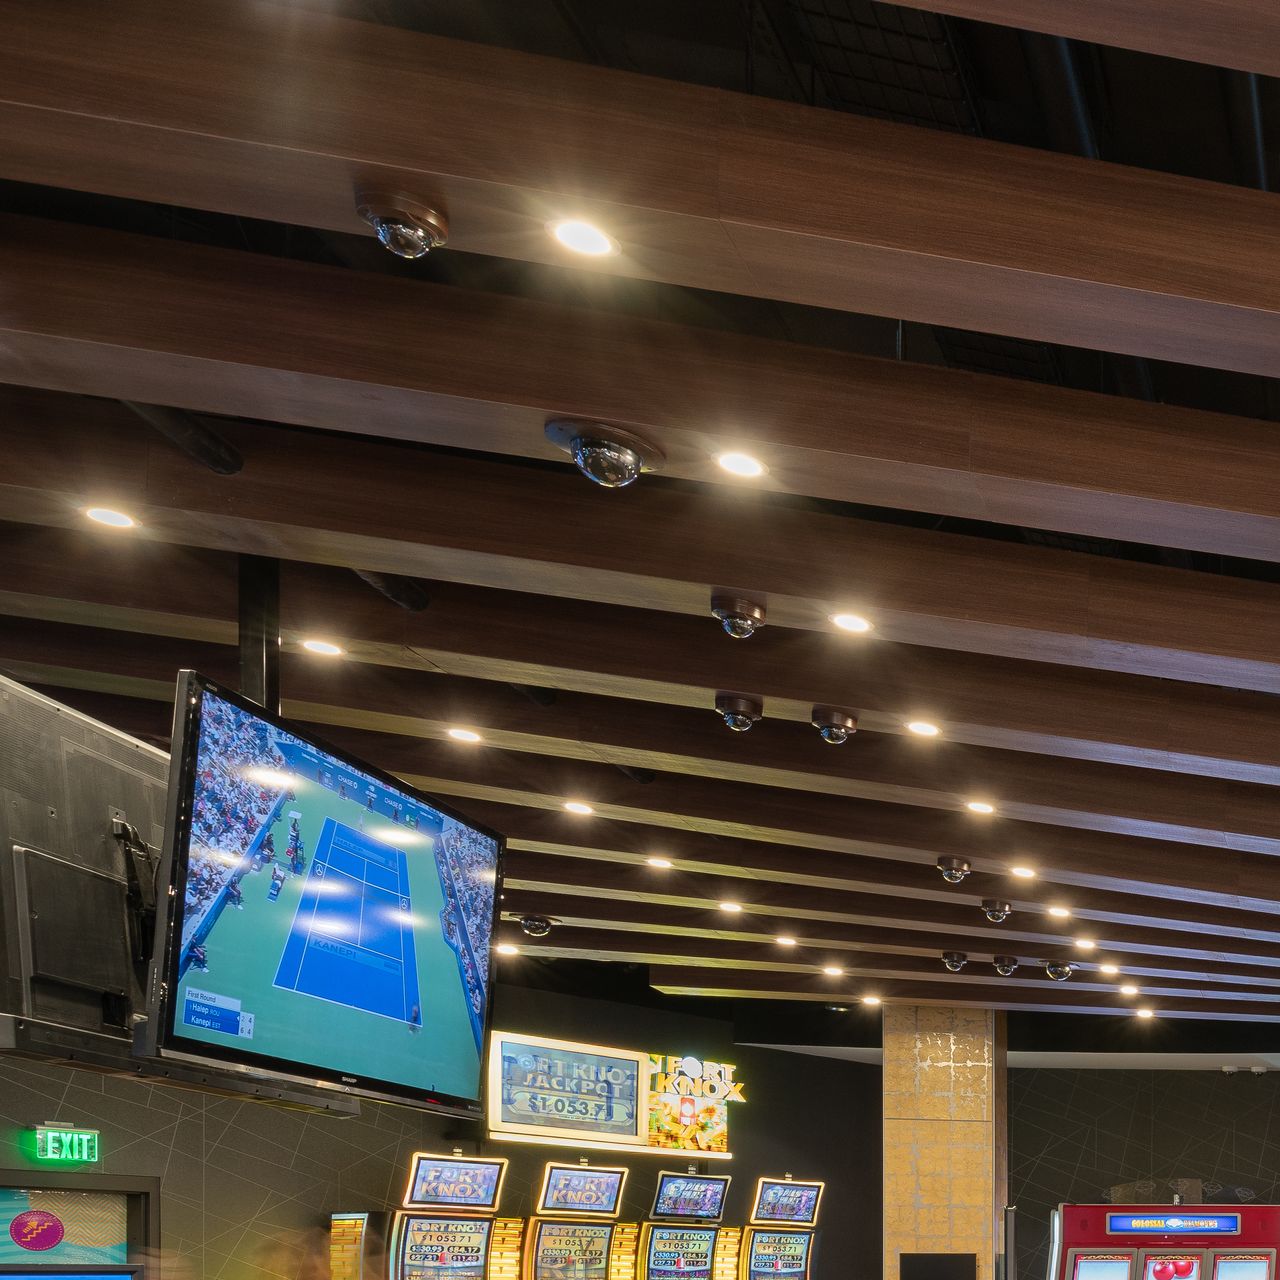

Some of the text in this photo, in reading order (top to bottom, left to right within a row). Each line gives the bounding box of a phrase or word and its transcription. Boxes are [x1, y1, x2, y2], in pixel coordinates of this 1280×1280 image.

[314, 938, 356, 958] KANEPI
[188, 990, 216, 1003] First Round
[192, 1003, 209, 1014] Halep
[191, 1015, 212, 1028] Kanepi
[668, 1056, 736, 1081] FORT
[524, 1073, 623, 1098] JACKPOT
[657, 1072, 746, 1102] KNOX
[48, 1132, 91, 1160] EXIT
[428, 1168, 486, 1183] FORT
[420, 1182, 488, 1198] KNOX
[552, 1190, 610, 1205] KNOX
[413, 1223, 448, 1232] FORT
[576, 1229, 606, 1237] KNOX
[656, 1232, 711, 1241] FORT KNOX
